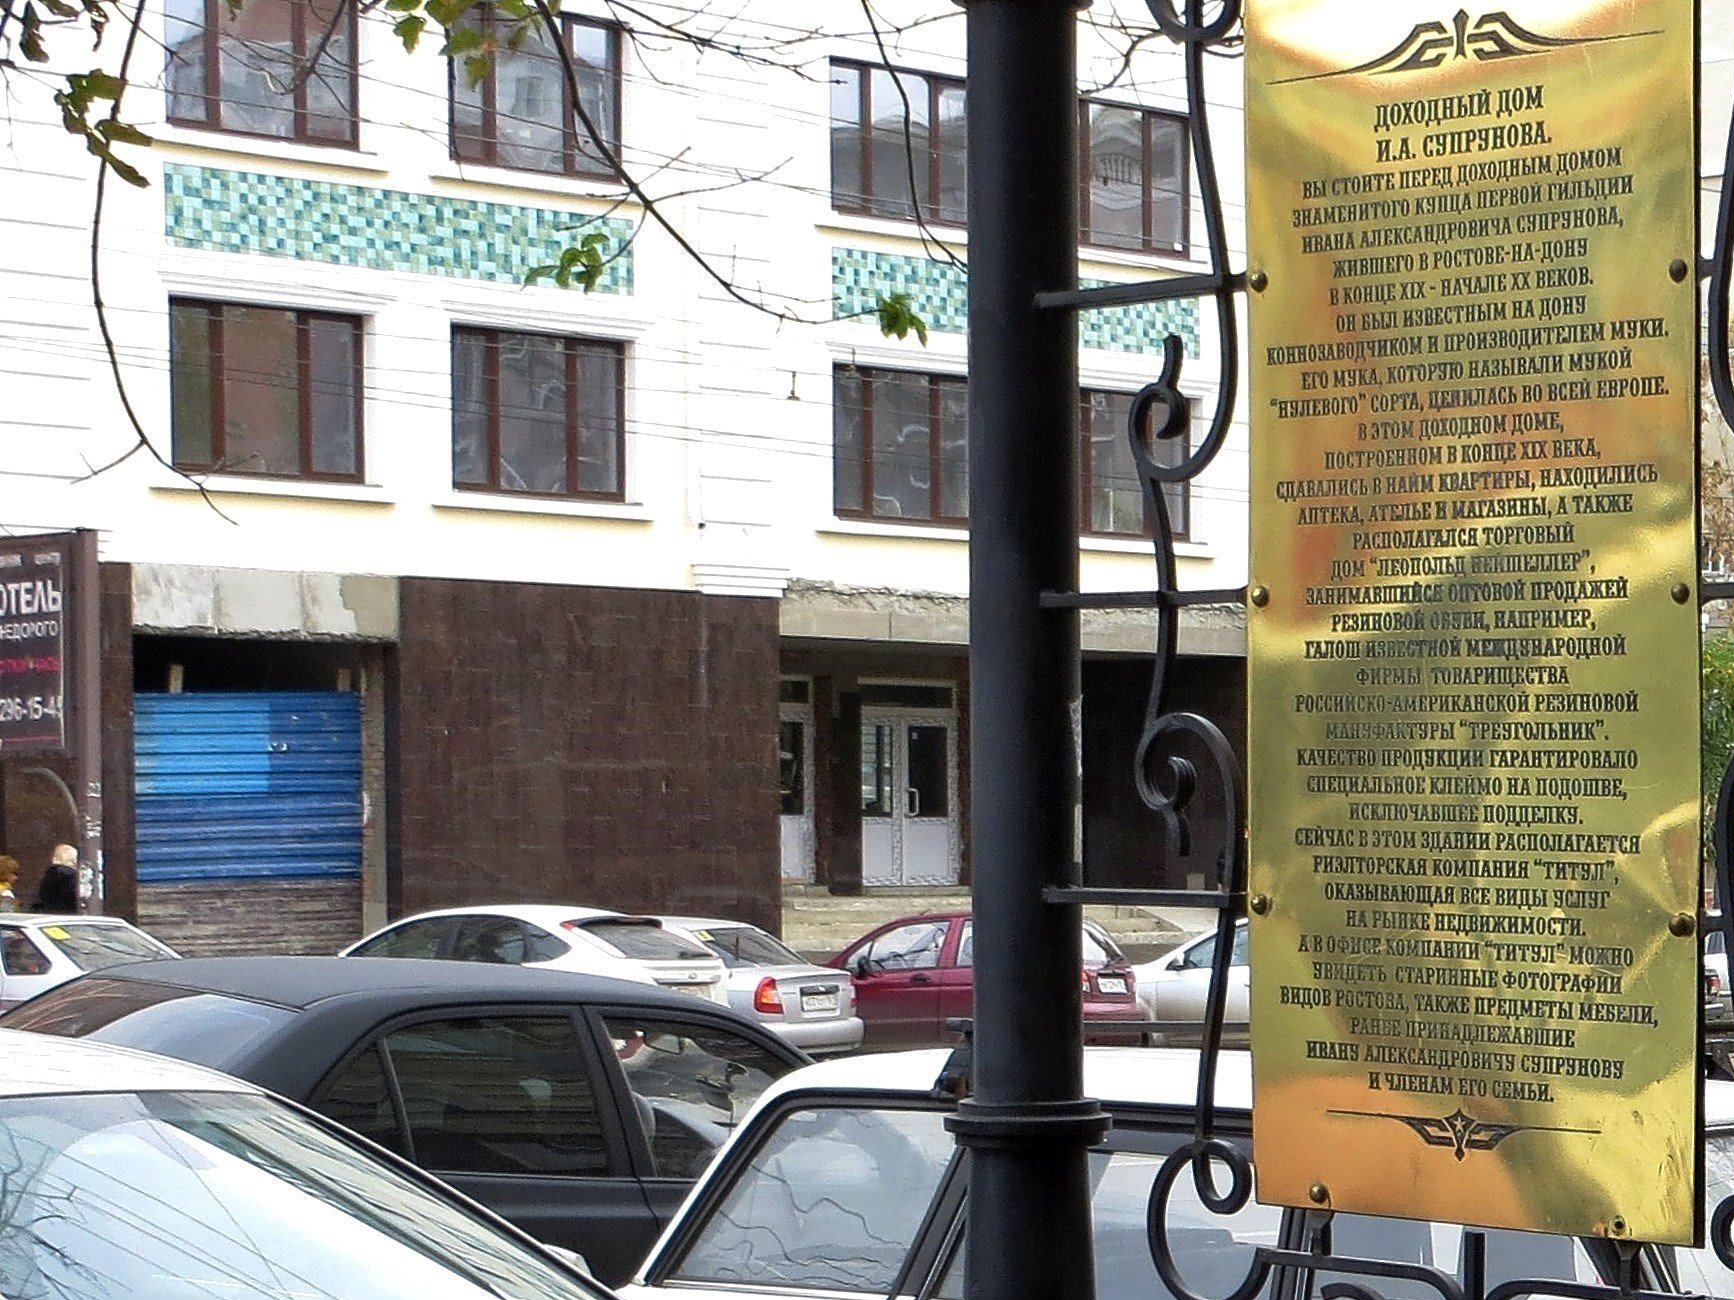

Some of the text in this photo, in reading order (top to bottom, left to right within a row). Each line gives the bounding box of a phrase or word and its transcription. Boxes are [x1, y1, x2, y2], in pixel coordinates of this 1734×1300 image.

[1374, 86, 1545, 130] ДОХОДНЫЙ ДОМ
[1422, 122, 1553, 157] СУПРУНОВА.
[1302, 147, 1623, 200] ВЫ СТОИТЕ ПЕРЕД ДОХОДНЫМ ДОМОМ
[1292, 175, 1634, 227] ЗНАМЕНИТОГО КУПЦА ПЕРВОЙ ГИЛЬДИИ
[1302, 208, 1624, 253] ИВАНА АЛЕКСАНДРОВИЧА СУПРУНОВА,
[1332, 237, 1589, 278] ЖИВШЕГО РОСТОВЕ-НА-ДОНУ
[1343, 266, 1594, 307] КОНЦЕ НАЧАЛЕ ВЕКОВ.
[1335, 295, 1588, 332] ОН БЫЛ ИЗВЕСТНЫМ НА ДОНУ
[1266, 320, 1670, 367] КОННОЗАВОДЧИКОМ ПРОИЗВОДИТЕЛЕМ МУКИ.
[1301, 348, 1633, 391] ЕГО МУКА, КОТОРУЮ НАЗЫВАЛИ МУКОЙ
[1370, 390, 1424, 415] СОРТА,
[1428, 385, 1518, 411] ЦЕНИЛАСЬ
[1521, 384, 1543, 404] ВО
[1547, 379, 1591, 403] ВСЕЙ
[1596, 377, 1670, 400] ЕВРОПЕ.
[1371, 411, 1565, 441] ЭТОМ ДОХОДНОМ ДОМЕ,
[1324, 439, 1602, 470] ПОСТРОЕННОМ КОНЦЕ ВЕКА,
[1276, 464, 1659, 501] СДАВАЛИСЬ НАЙМ КВАРТИРЫ, НАХОДИЛИСЬ
[1298, 503, 1364, 527] АПТЕКА,
[1369, 501, 1432, 522] АТЕЛЬЕ
[1451, 497, 1552, 522] МАГАЗИНЫ,
[1352, 522, 1575, 551] РАСПОЛАГАЛСЯ ТОРГОВЫЙ
[1330, 558, 1365, 580] ДОМ
[1305, 577, 1629, 605] ЗАНИМАВШИЙСЯ ОПТОВОЙ ПРОДАЖЕЙ
[1331, 609, 1424, 631] РЕЗИНОВОЙ
[1493, 609, 1597, 632] НАПРИМЕР,
[1303, 640, 1361, 659] ГАЛОШ
[1356, 664, 1570, 688] ФИРМЫ ТОВАРИЩЕСТВА
[1294, 690, 1639, 713] РОССИЙСКО-АМЕРИКАНСКОЙ РЕЗИНОВОЙ
[1324, 721, 1456, 740] МАНУФАКТУРЫ
[1296, 748, 1639, 770] КАЧЕСТВО ПРОДУКЦИИ ГАРАНТИРОВАЛО
[1306, 774, 1629, 800] СПЕЦИАЛЬНОЕ КЛЕЙМО НА ПОДОШВЕ,
[1348, 803, 1585, 828] ИСКЛЮЧАВШЕЕ ПОДДЕЛКУ.
[1294, 826, 1642, 854] СЕЙЧАС ЭТОМ ЗДАНИИ РАСПОЛАГАЕТСЯ
[1312, 855, 1428, 876] РИЭЛТОРСКАЯ
[1432, 858, 1529, 879] КОМПАНИЯ
[1324, 883, 1611, 910] ОКАЗЫВАЮЩАЯ ВСЕ ВИДЫ УСЛУГ
[1345, 910, 1587, 939] НА РЫНКЕ НЕДВИЖИМОСТИ.
[1326, 936, 1381, 957] ОФИСЕ
[1386, 939, 1480, 960] КОМПАНИИ
[1569, 945, 1634, 966] МОЖНО
[1312, 963, 1623, 994] УВИДЕТЬ СТАРИННЫЕ ФОТОГРАФИИ
[1279, 987, 1332, 1011] ВИДОВ
[1474, 997, 1574, 1022] ПРЕДМЕТЫ
[1578, 1002, 1659, 1027] МЕБЕЛИ,
[1349, 1017, 1576, 1050] РАНЕЕ ПРИНАДЛЕЖАВШИЕ
[1306, 1041, 1624, 1077] ИВАНУ АЛЕКСАНДРОВИЧУ СУПРУНОВУ
[1385, 1074, 1556, 1102] ЧЛЕНАМ ЕГО СЕМЬИ.
